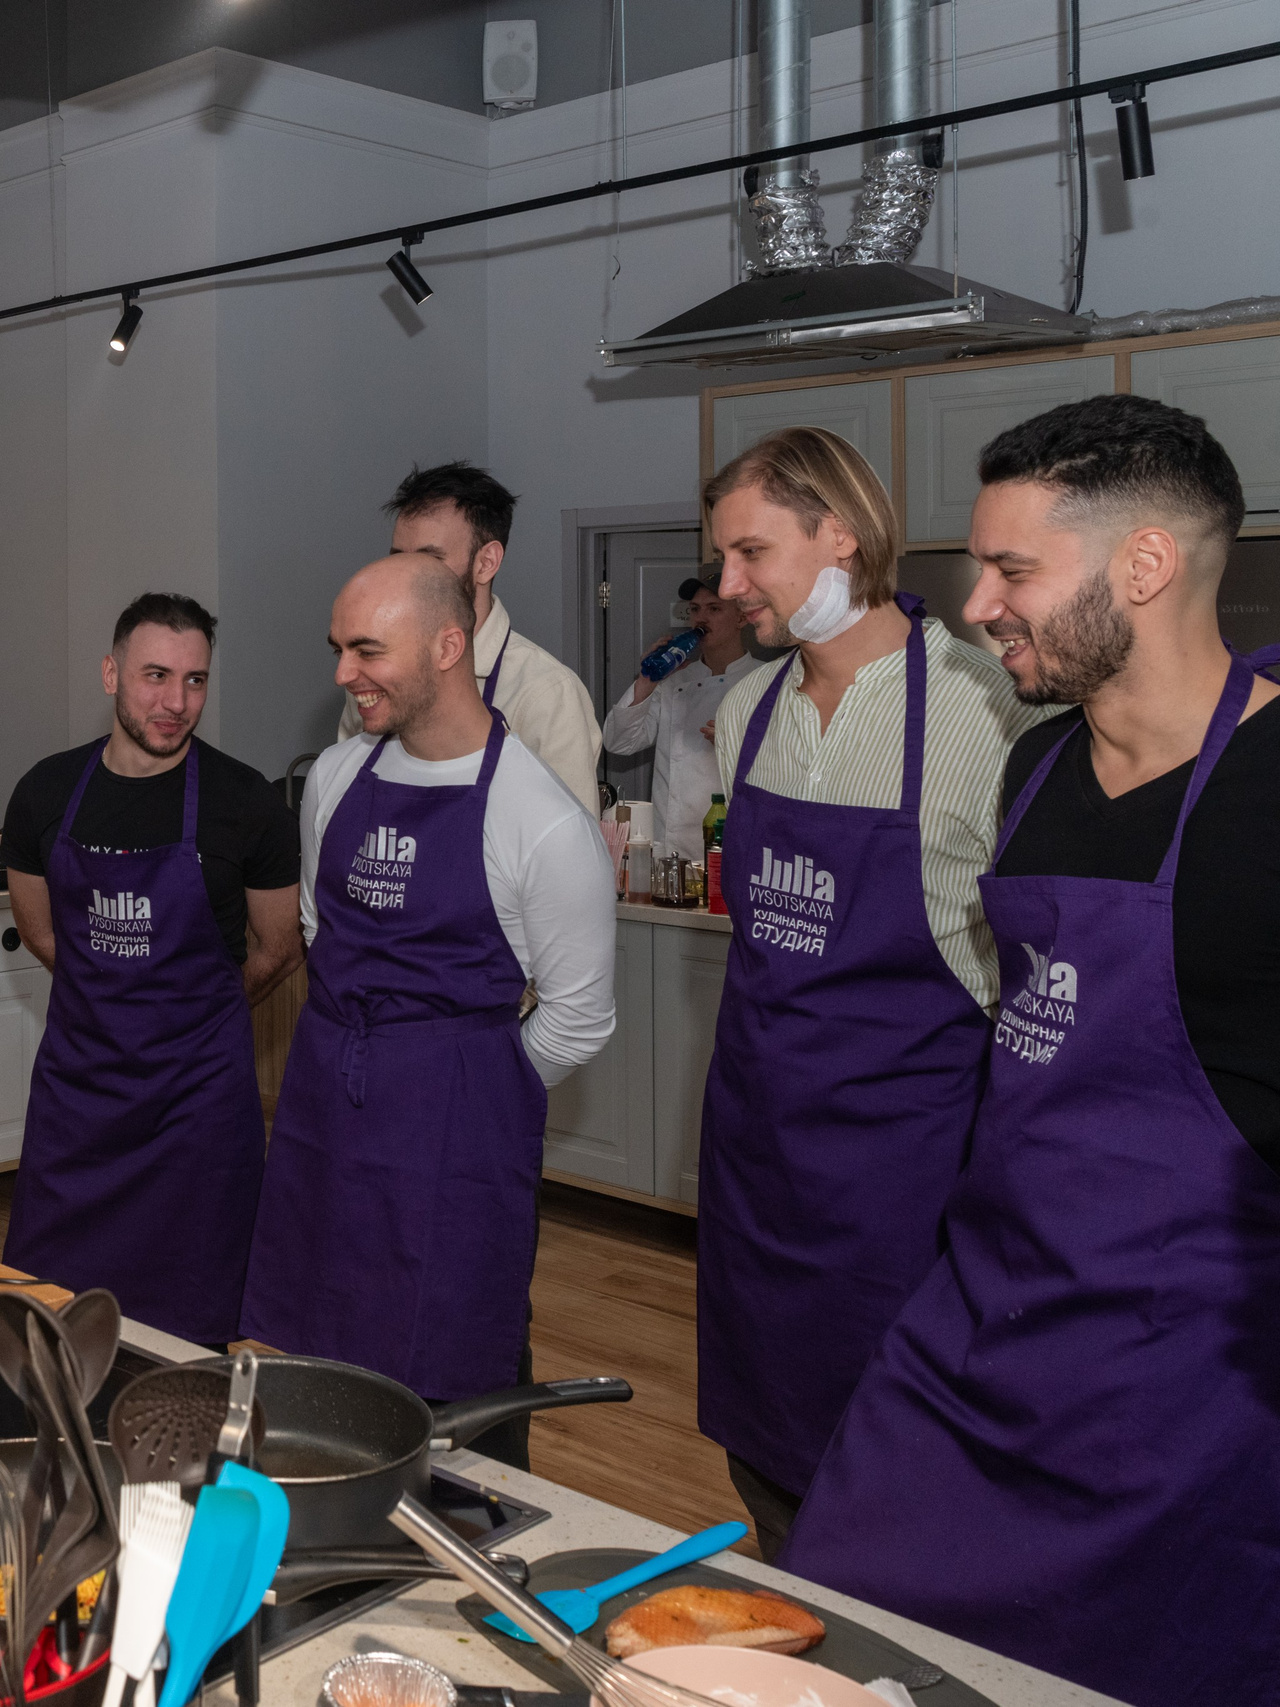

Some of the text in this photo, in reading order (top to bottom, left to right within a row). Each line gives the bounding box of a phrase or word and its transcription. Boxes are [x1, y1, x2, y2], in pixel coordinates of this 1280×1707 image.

[749, 846, 835, 903] Julia
[88, 889, 151, 920] Julia
[347, 883, 405, 909] СТУДИЯ
[749, 885, 834, 922] VYSOTSKAYA
[88, 913, 153, 932] VYSOTSKAYA
[90, 929, 149, 944] КУЛИНАРНАЯ
[753, 908, 828, 938] КУЛИНАРНАЯ
[91, 939, 150, 958] СТУДИЯ
[751, 921, 826, 957] СТУДИЯ
[995, 1022, 1059, 1066] СТУДИЯ
